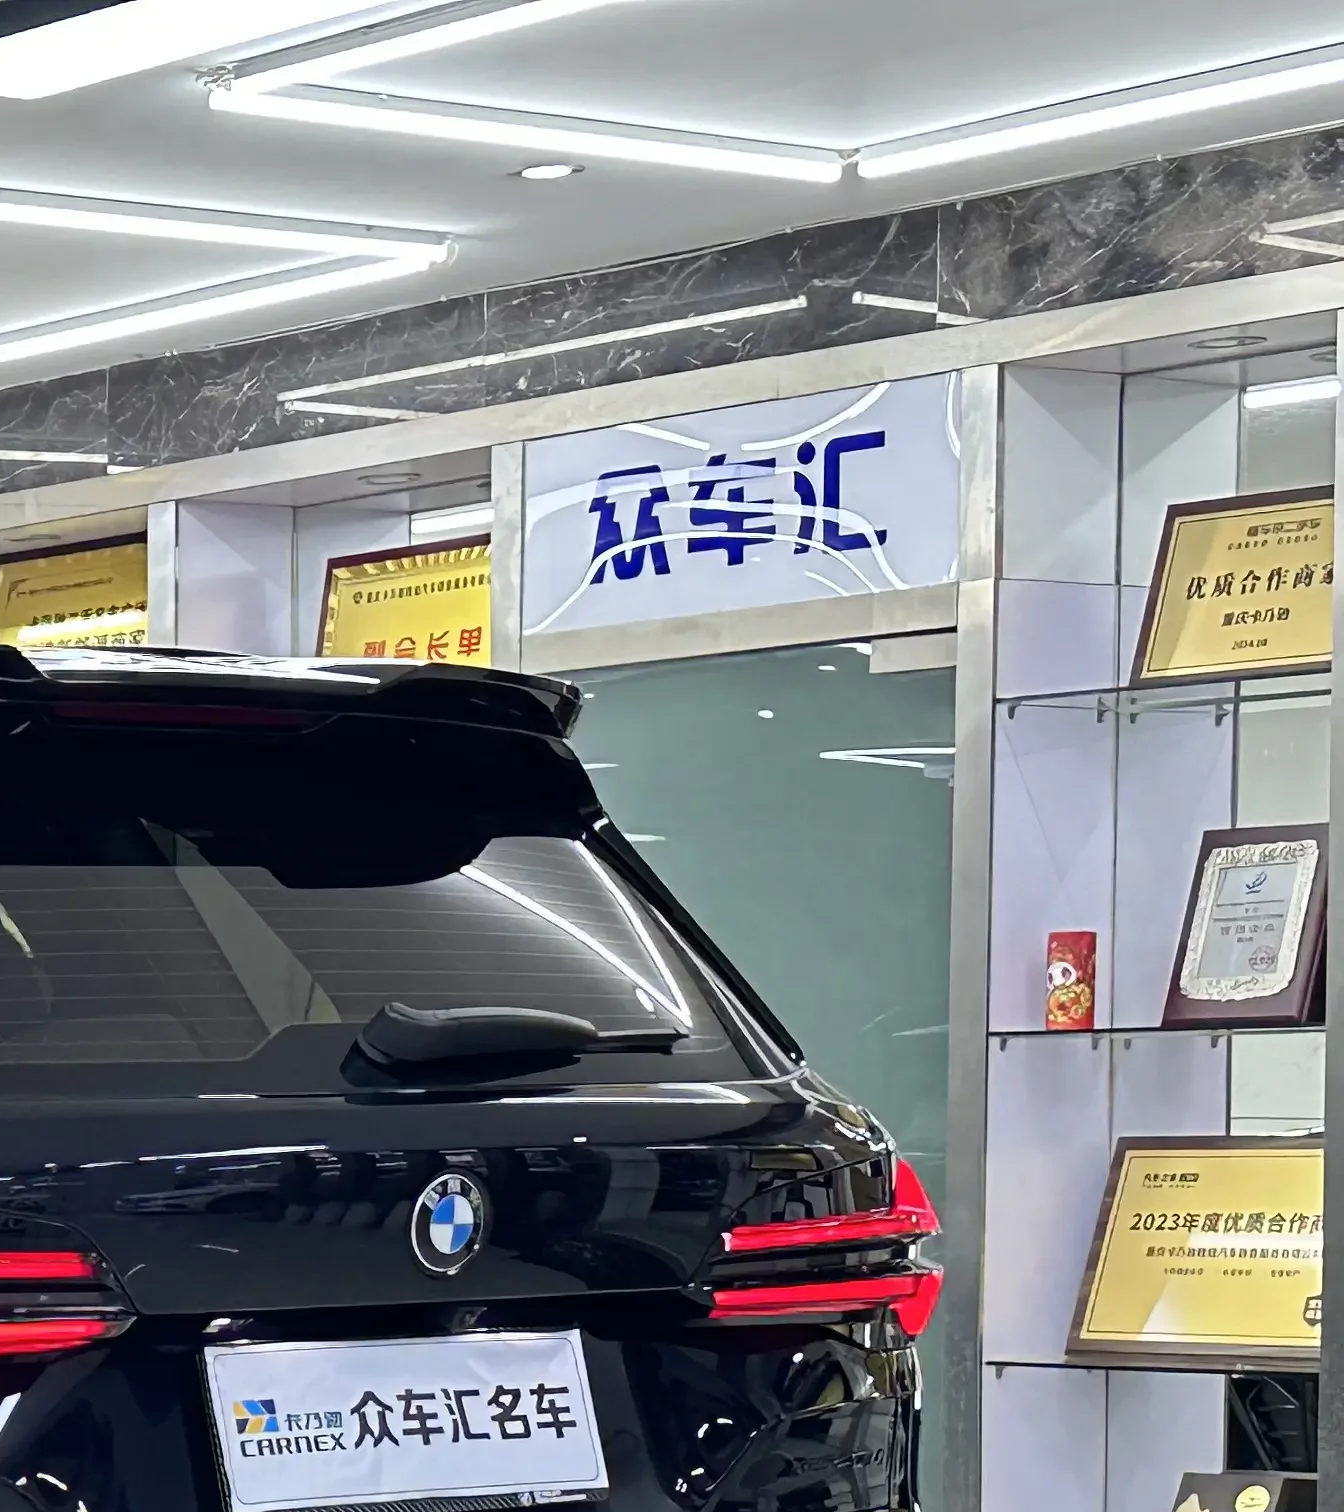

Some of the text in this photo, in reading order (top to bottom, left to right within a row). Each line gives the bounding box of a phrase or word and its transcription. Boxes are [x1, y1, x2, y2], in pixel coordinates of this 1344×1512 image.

[589, 430, 887, 584] 众车汇
[240, 1432, 348, 1458] CARNEX
[350, 1383, 577, 1450] 众车汇名车
